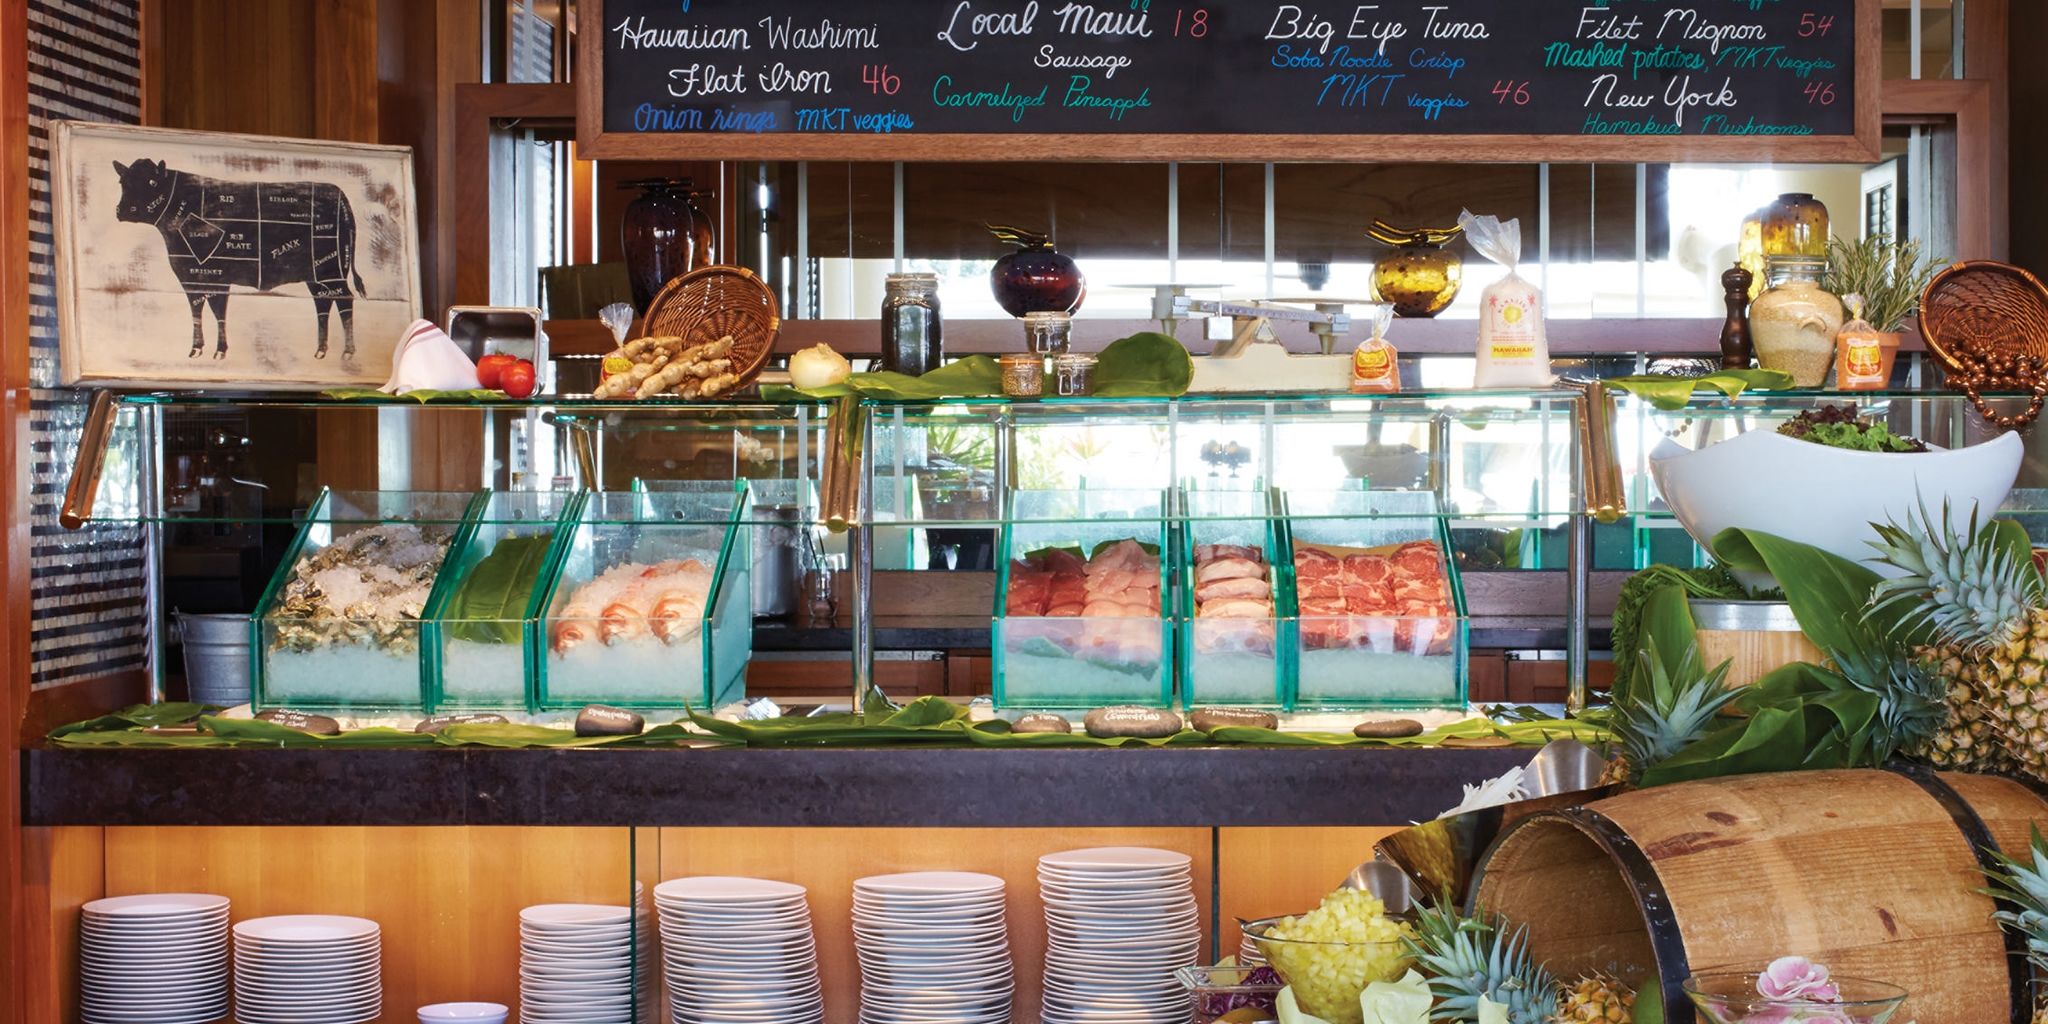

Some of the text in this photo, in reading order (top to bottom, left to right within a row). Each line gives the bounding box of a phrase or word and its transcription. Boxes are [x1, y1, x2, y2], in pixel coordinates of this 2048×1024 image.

[613, 17, 750, 50] Hawaiian
[937, 1, 1039, 51] Local
[1053, 2, 1152, 37] Maui
[1265, 5, 1490, 56] Big Eye Tuna
[1576, 7, 1834, 55] Filet Mignon 54
[1034, 44, 1132, 79] Sausage
[1271, 45, 1465, 79] Soba Noodle Crisp
[1544, 42, 1627, 68] Mashed
[1716, 46, 1785, 69] MKT
[667, 63, 747, 97] Flat
[862, 64, 901, 95] 46
[1316, 73, 1406, 106] MKT
[1491, 80, 1530, 105] 46
[933, 75, 1151, 122] Carmelized Pineapple
[1584, 73, 1835, 127] New York 46
[634, 102, 914, 133] Onion rings MKT veggies
[1582, 113, 1815, 135] Hamakua Mushrooms
[219, 195, 235, 203] RIB
[226, 242, 252, 250] PLATE
[271, 239, 301, 259] FLANK
[190, 268, 223, 276] BRISKET
